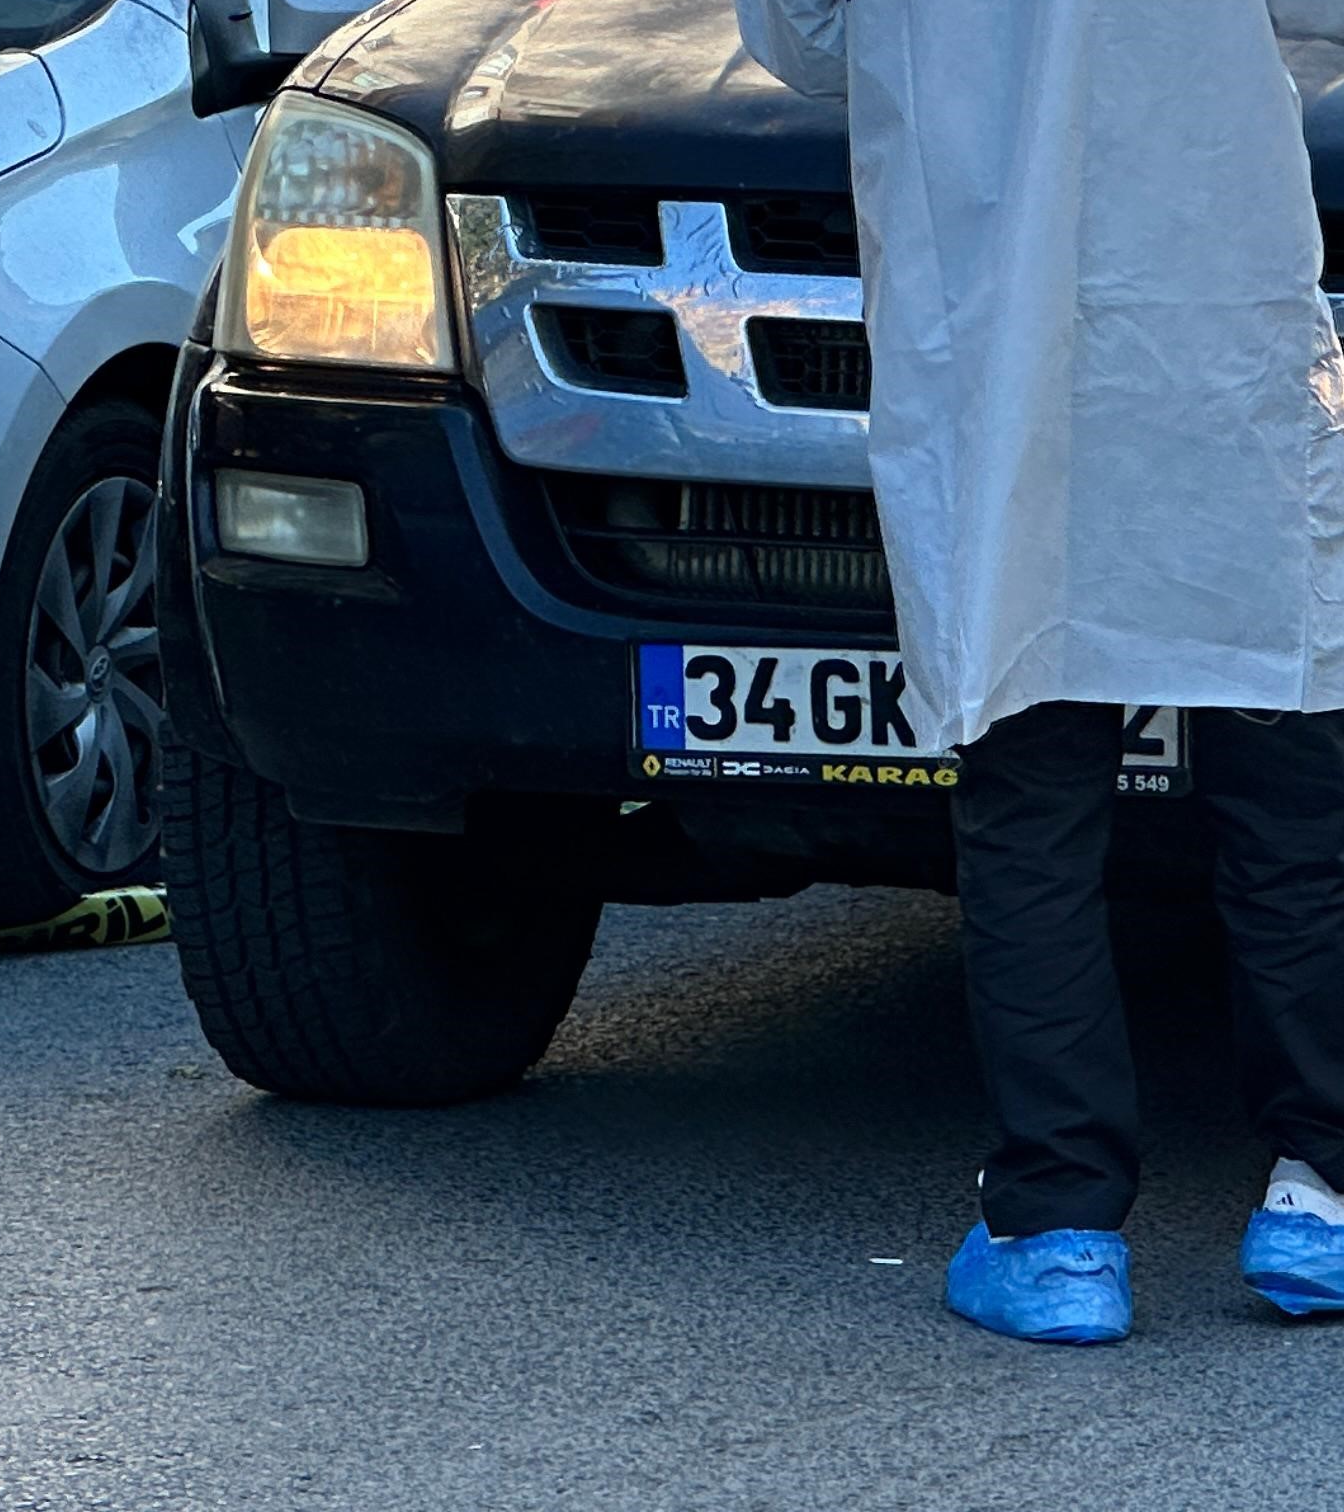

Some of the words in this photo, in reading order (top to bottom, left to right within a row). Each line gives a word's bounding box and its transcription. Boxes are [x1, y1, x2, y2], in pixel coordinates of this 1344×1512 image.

[685, 653, 797, 745] 34
[647, 704, 681, 731] TR
[1135, 774, 1170, 793] 549
